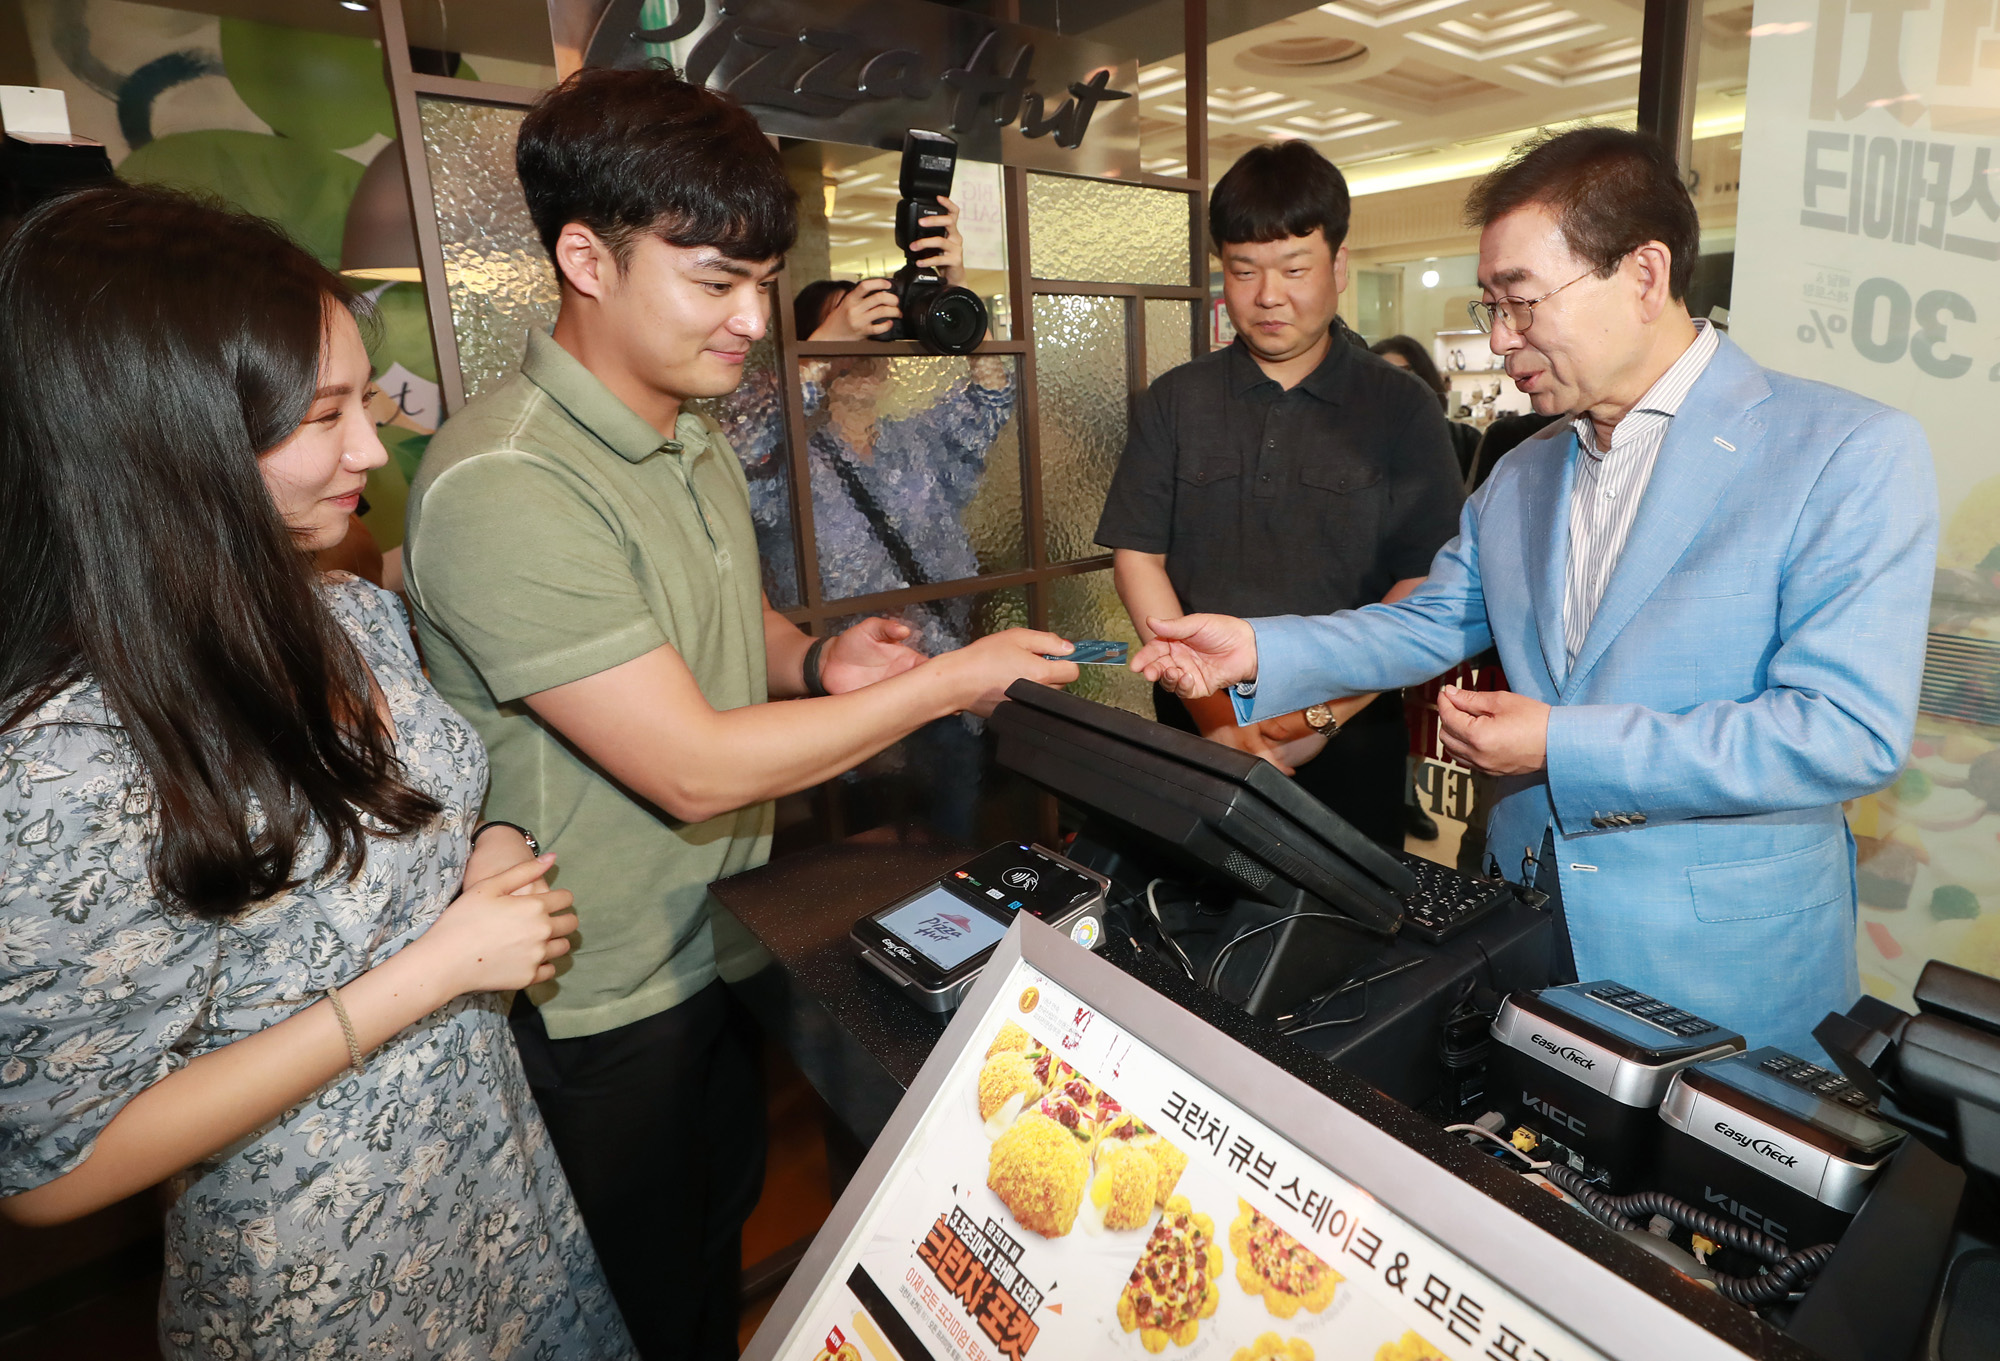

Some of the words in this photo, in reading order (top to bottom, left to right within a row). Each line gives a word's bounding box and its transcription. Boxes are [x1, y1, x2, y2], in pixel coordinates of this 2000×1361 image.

[940, 28, 1132, 149] Hut
[918, 273, 939, 282] Canon
[914, 927, 951, 943] Hut
[918, 917, 962, 938] Pizza
[1522, 1091, 1587, 1137] KICC
[1160, 1091, 1227, 1156] 크런치
[1227, 1135, 1277, 1191] 큐브
[1275, 1177, 1384, 1270] 스테이크
[1385, 1252, 1411, 1295] &
[1414, 1274, 1486, 1347] 모든
[1704, 1186, 1788, 1242] KICC
[905, 1267, 925, 1294] 이제
[920, 1284, 940, 1312] 모든
[935, 1303, 971, 1349] 프리미엄
[989, 1253, 1019, 1291] 판매
[1011, 1277, 1041, 1315] 신화
[829, 1331, 842, 1348] NEW
